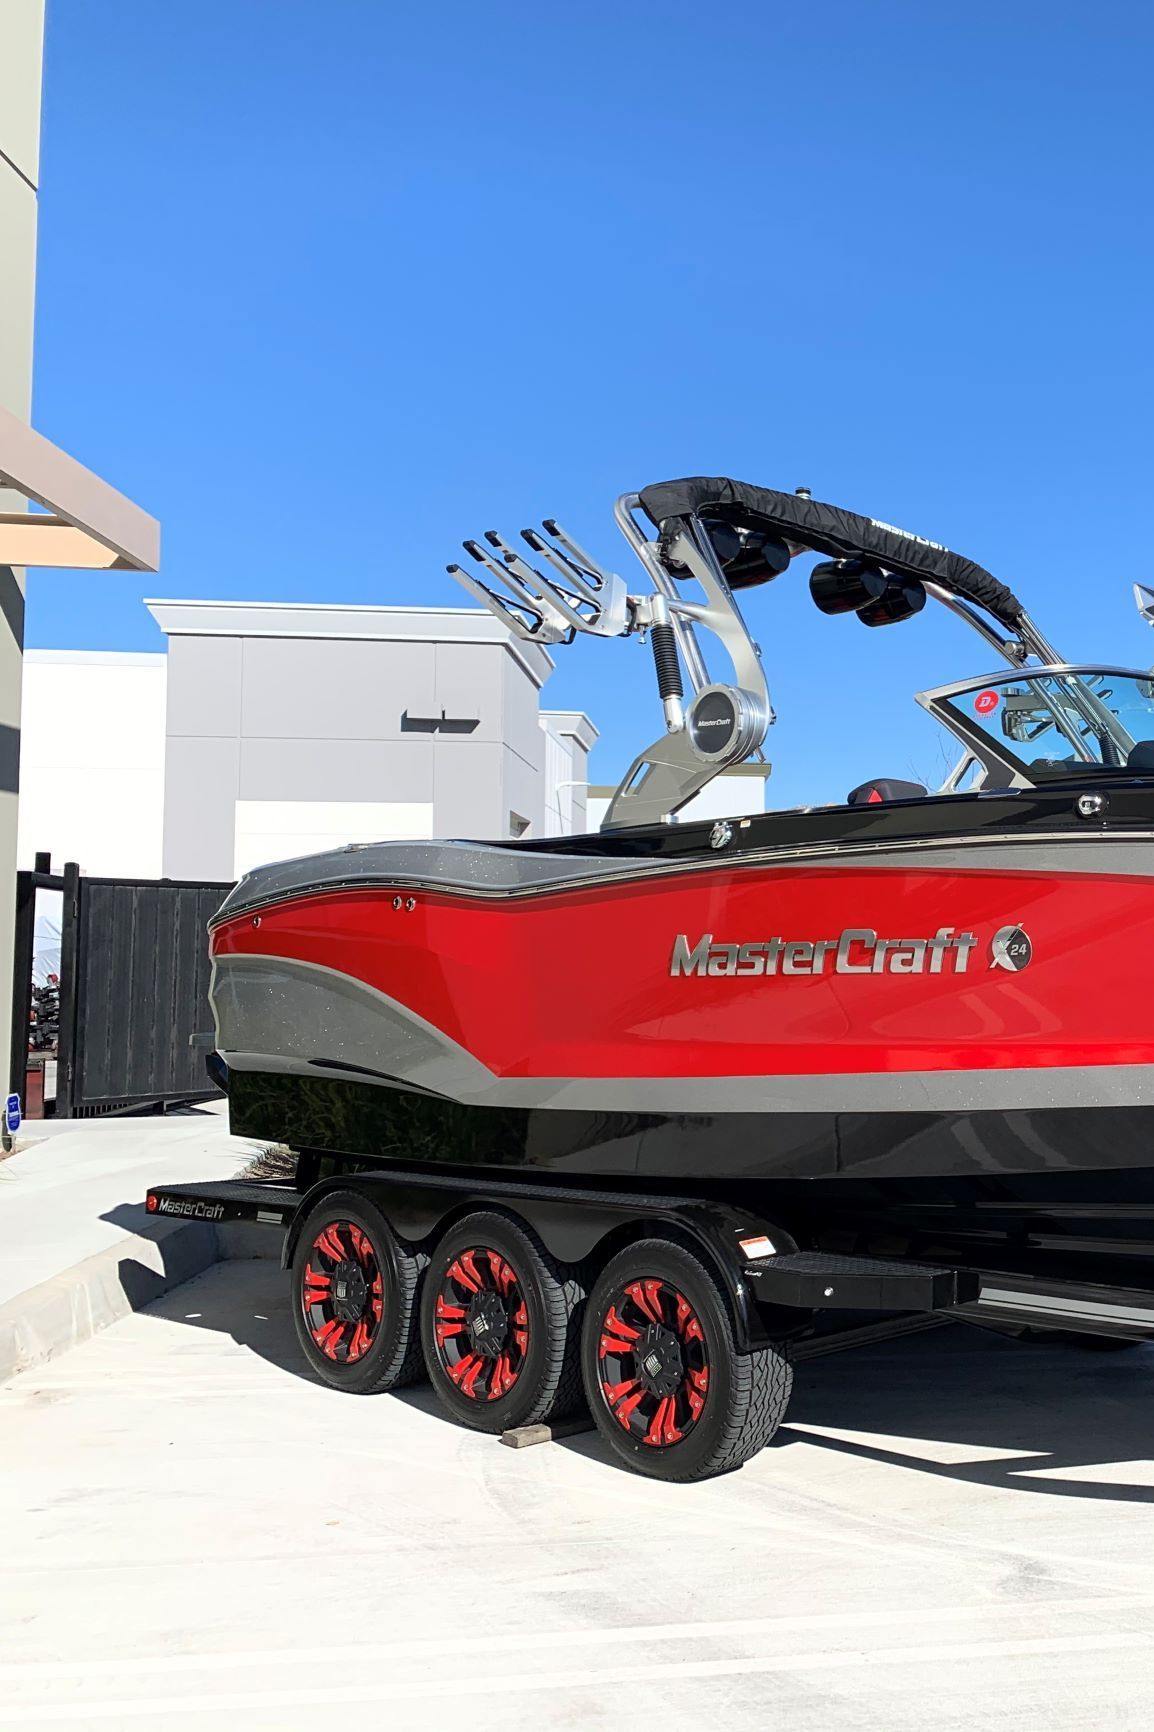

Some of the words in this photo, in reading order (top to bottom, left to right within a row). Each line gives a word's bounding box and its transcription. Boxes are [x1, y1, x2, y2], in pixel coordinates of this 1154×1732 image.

[698, 718, 731, 727] MasterCraft
[669, 927, 979, 977] MasterCraft
[158, 1197, 225, 1219] MasterCraft
